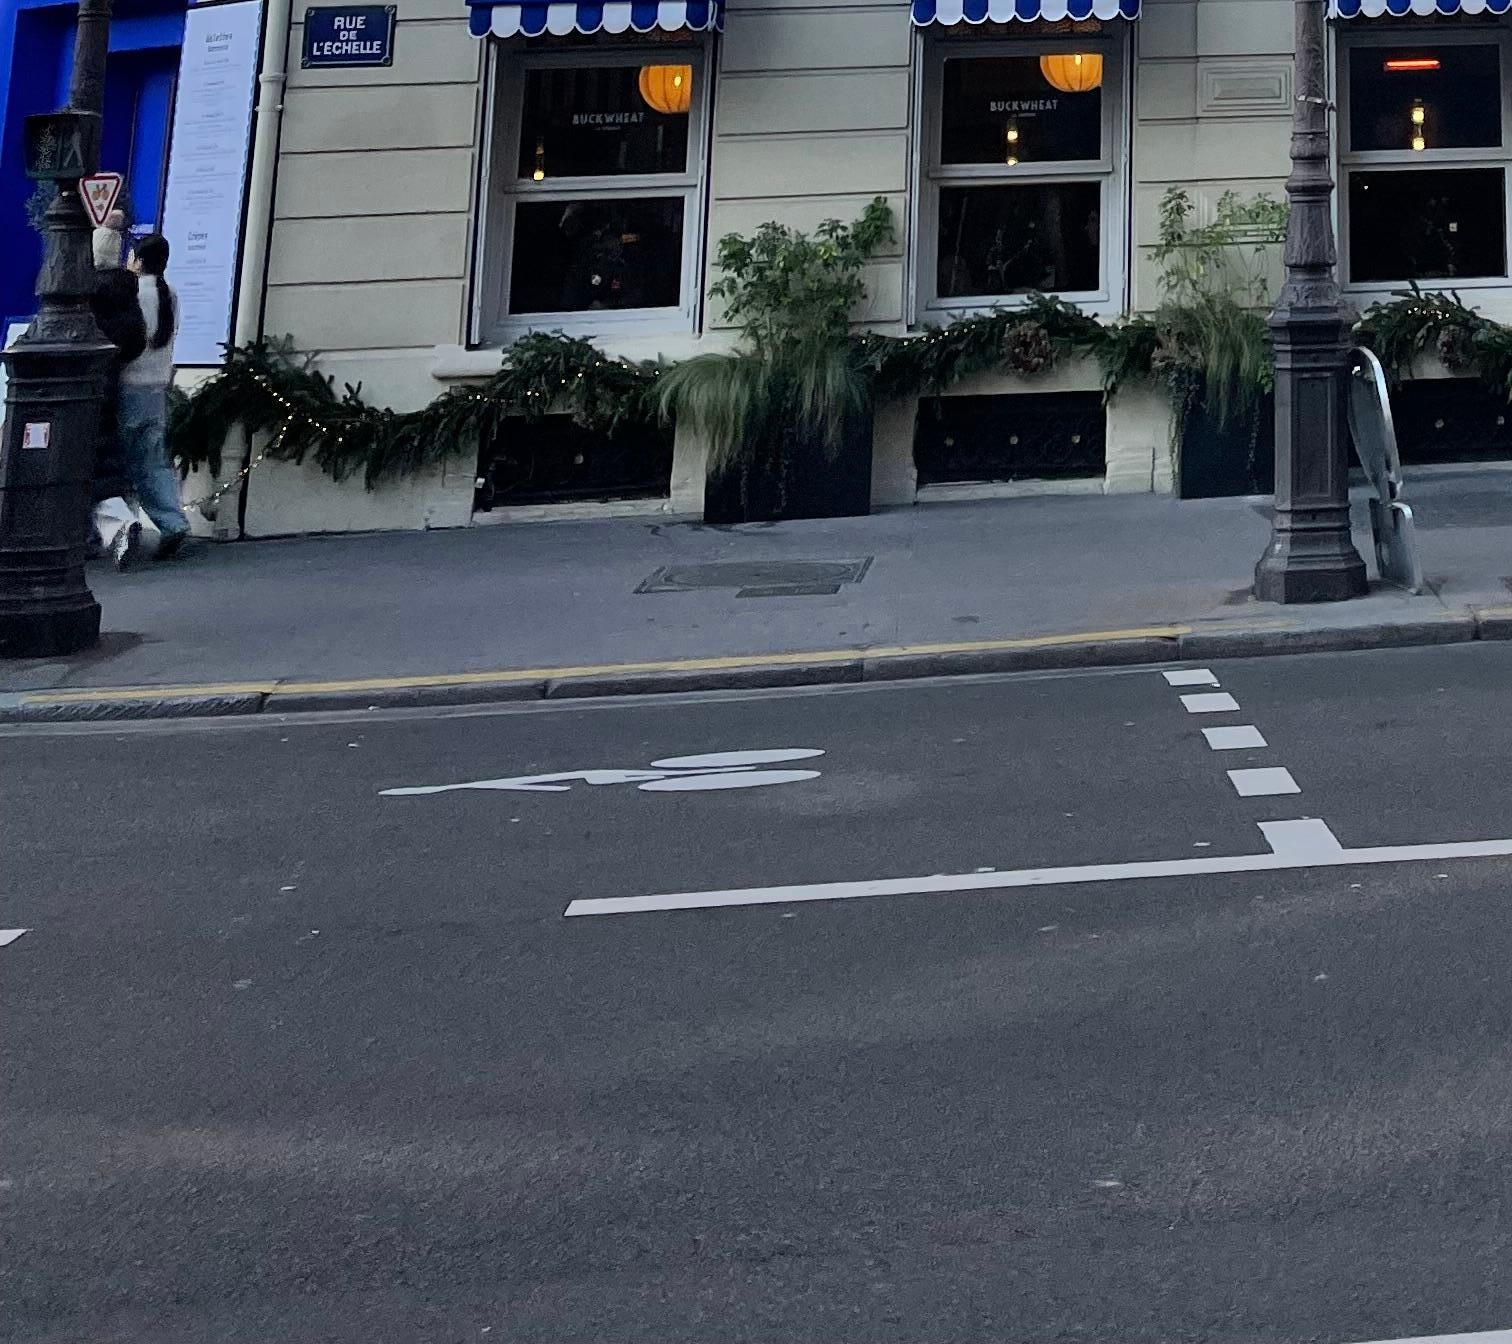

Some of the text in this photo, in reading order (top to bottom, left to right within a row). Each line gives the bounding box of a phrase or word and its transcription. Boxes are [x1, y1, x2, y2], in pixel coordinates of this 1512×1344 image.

[333, 15, 367, 30] RUE
[339, 30, 358, 41] DE
[989, 99, 1059, 112] BUCKWHEAT
[572, 112, 645, 125] BUCKWHEAT
